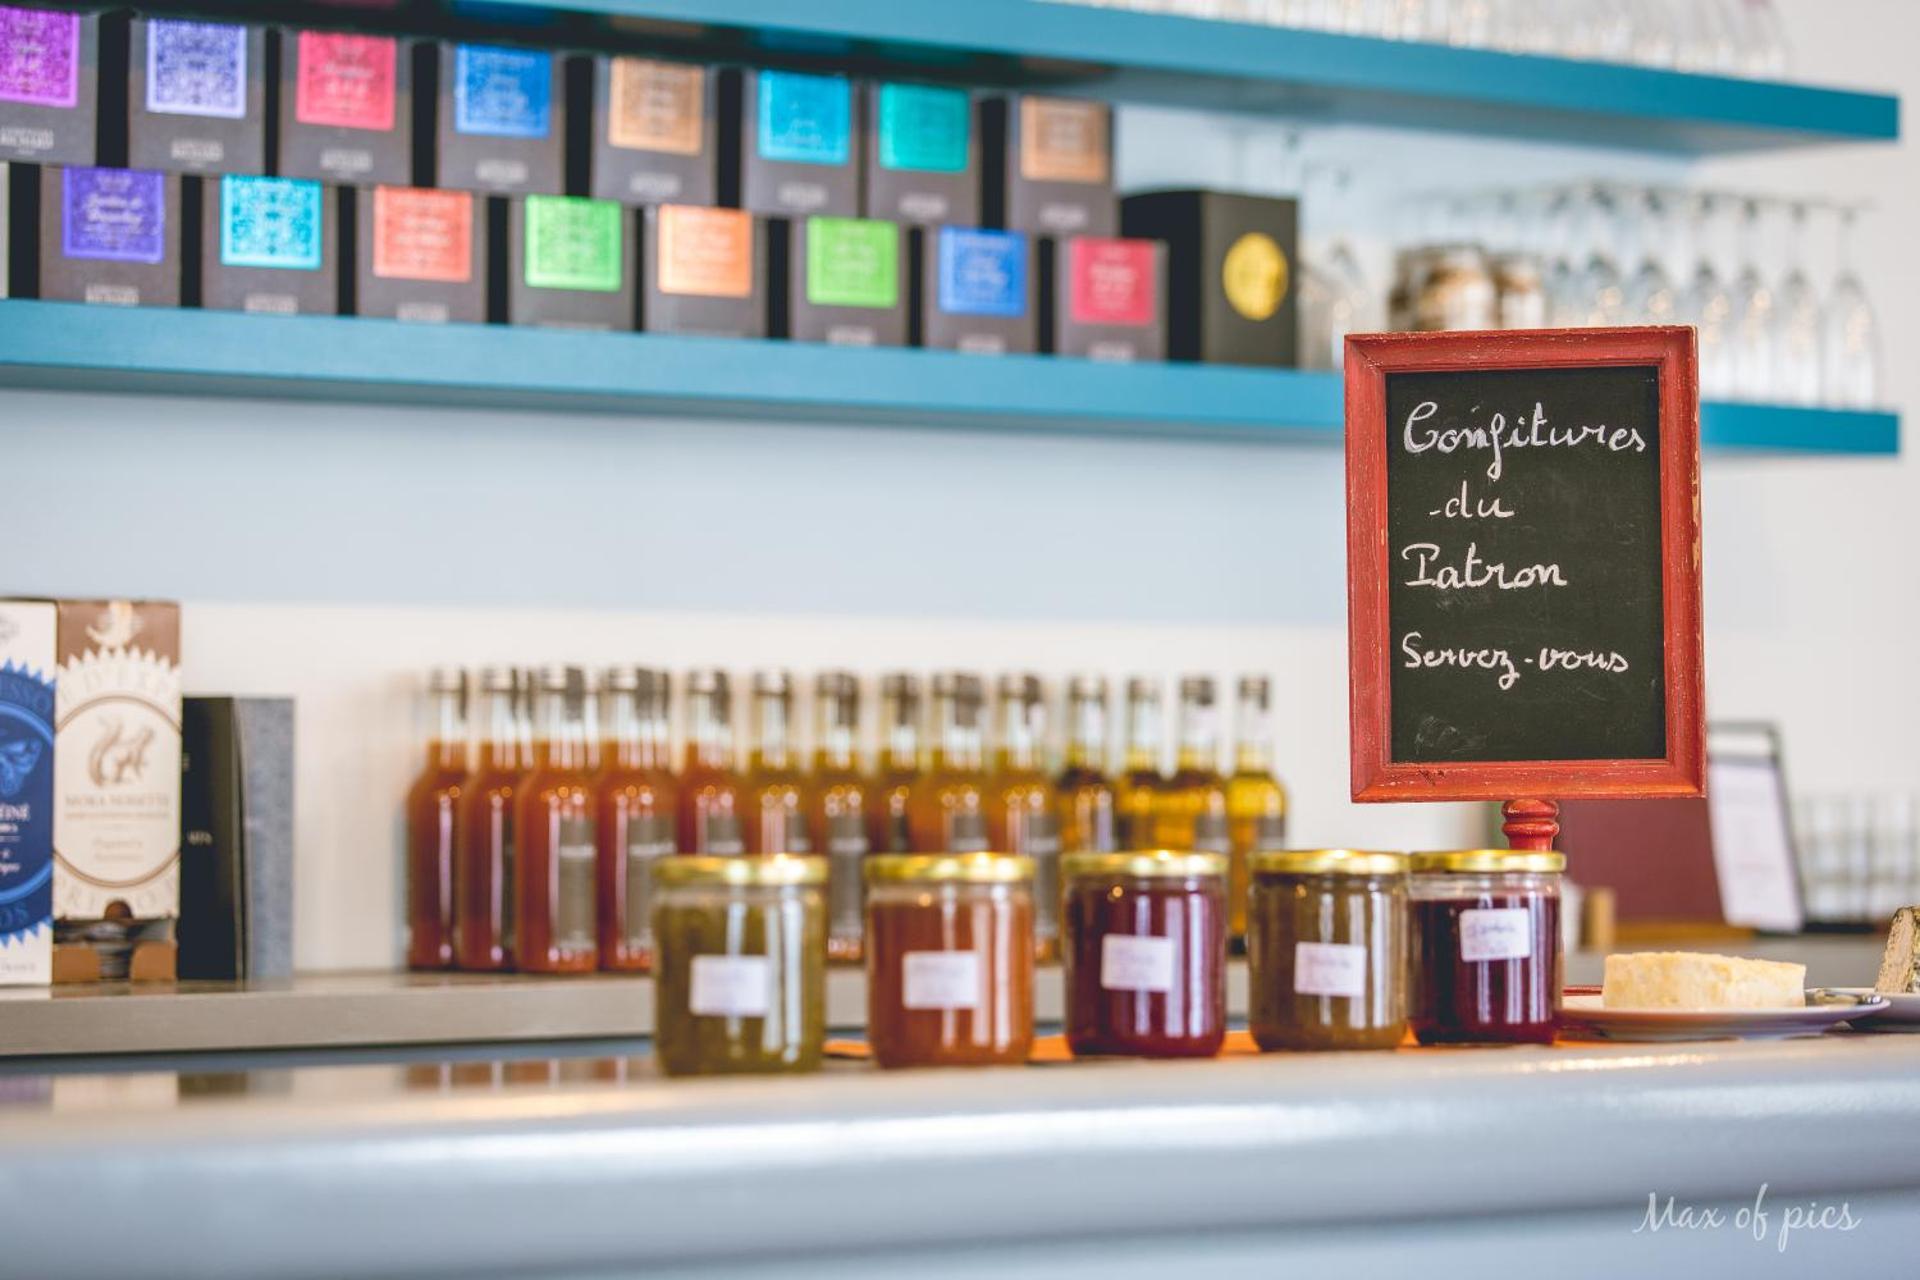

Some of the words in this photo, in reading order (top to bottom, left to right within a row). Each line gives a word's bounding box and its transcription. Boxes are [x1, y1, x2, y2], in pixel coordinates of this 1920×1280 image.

[1403, 401, 1647, 480] Confitures
[1401, 542, 1568, 590] Patron
[1402, 631, 1629, 691] Servez-vous
